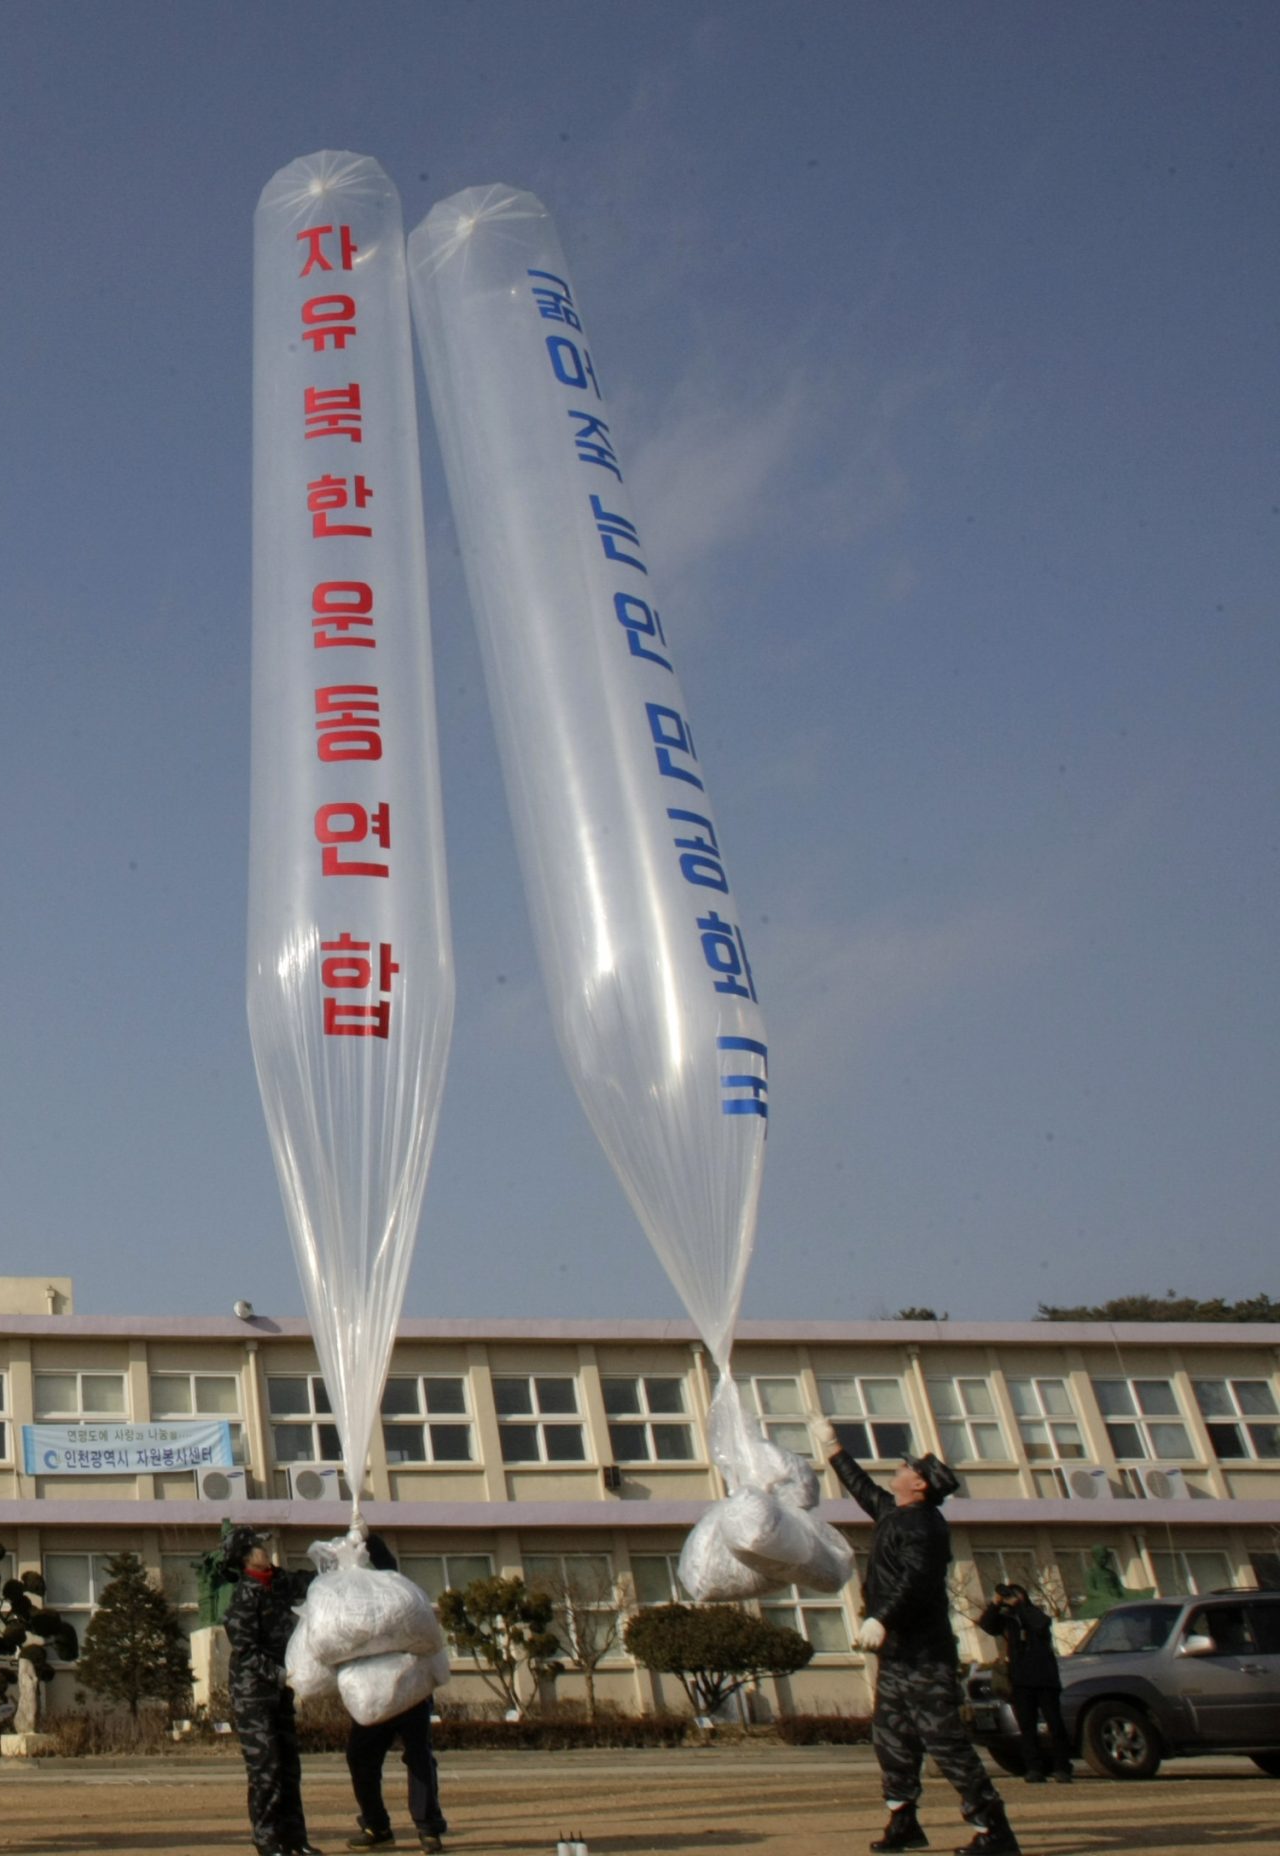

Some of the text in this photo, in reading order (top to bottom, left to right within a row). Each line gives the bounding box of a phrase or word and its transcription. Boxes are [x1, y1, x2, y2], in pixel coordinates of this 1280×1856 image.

[67, 1430, 109, 1443] 연평도에
[114, 1429, 145, 1443] 사랑과
[64, 1446, 213, 1469] 인천광역시 자원봉사센터
